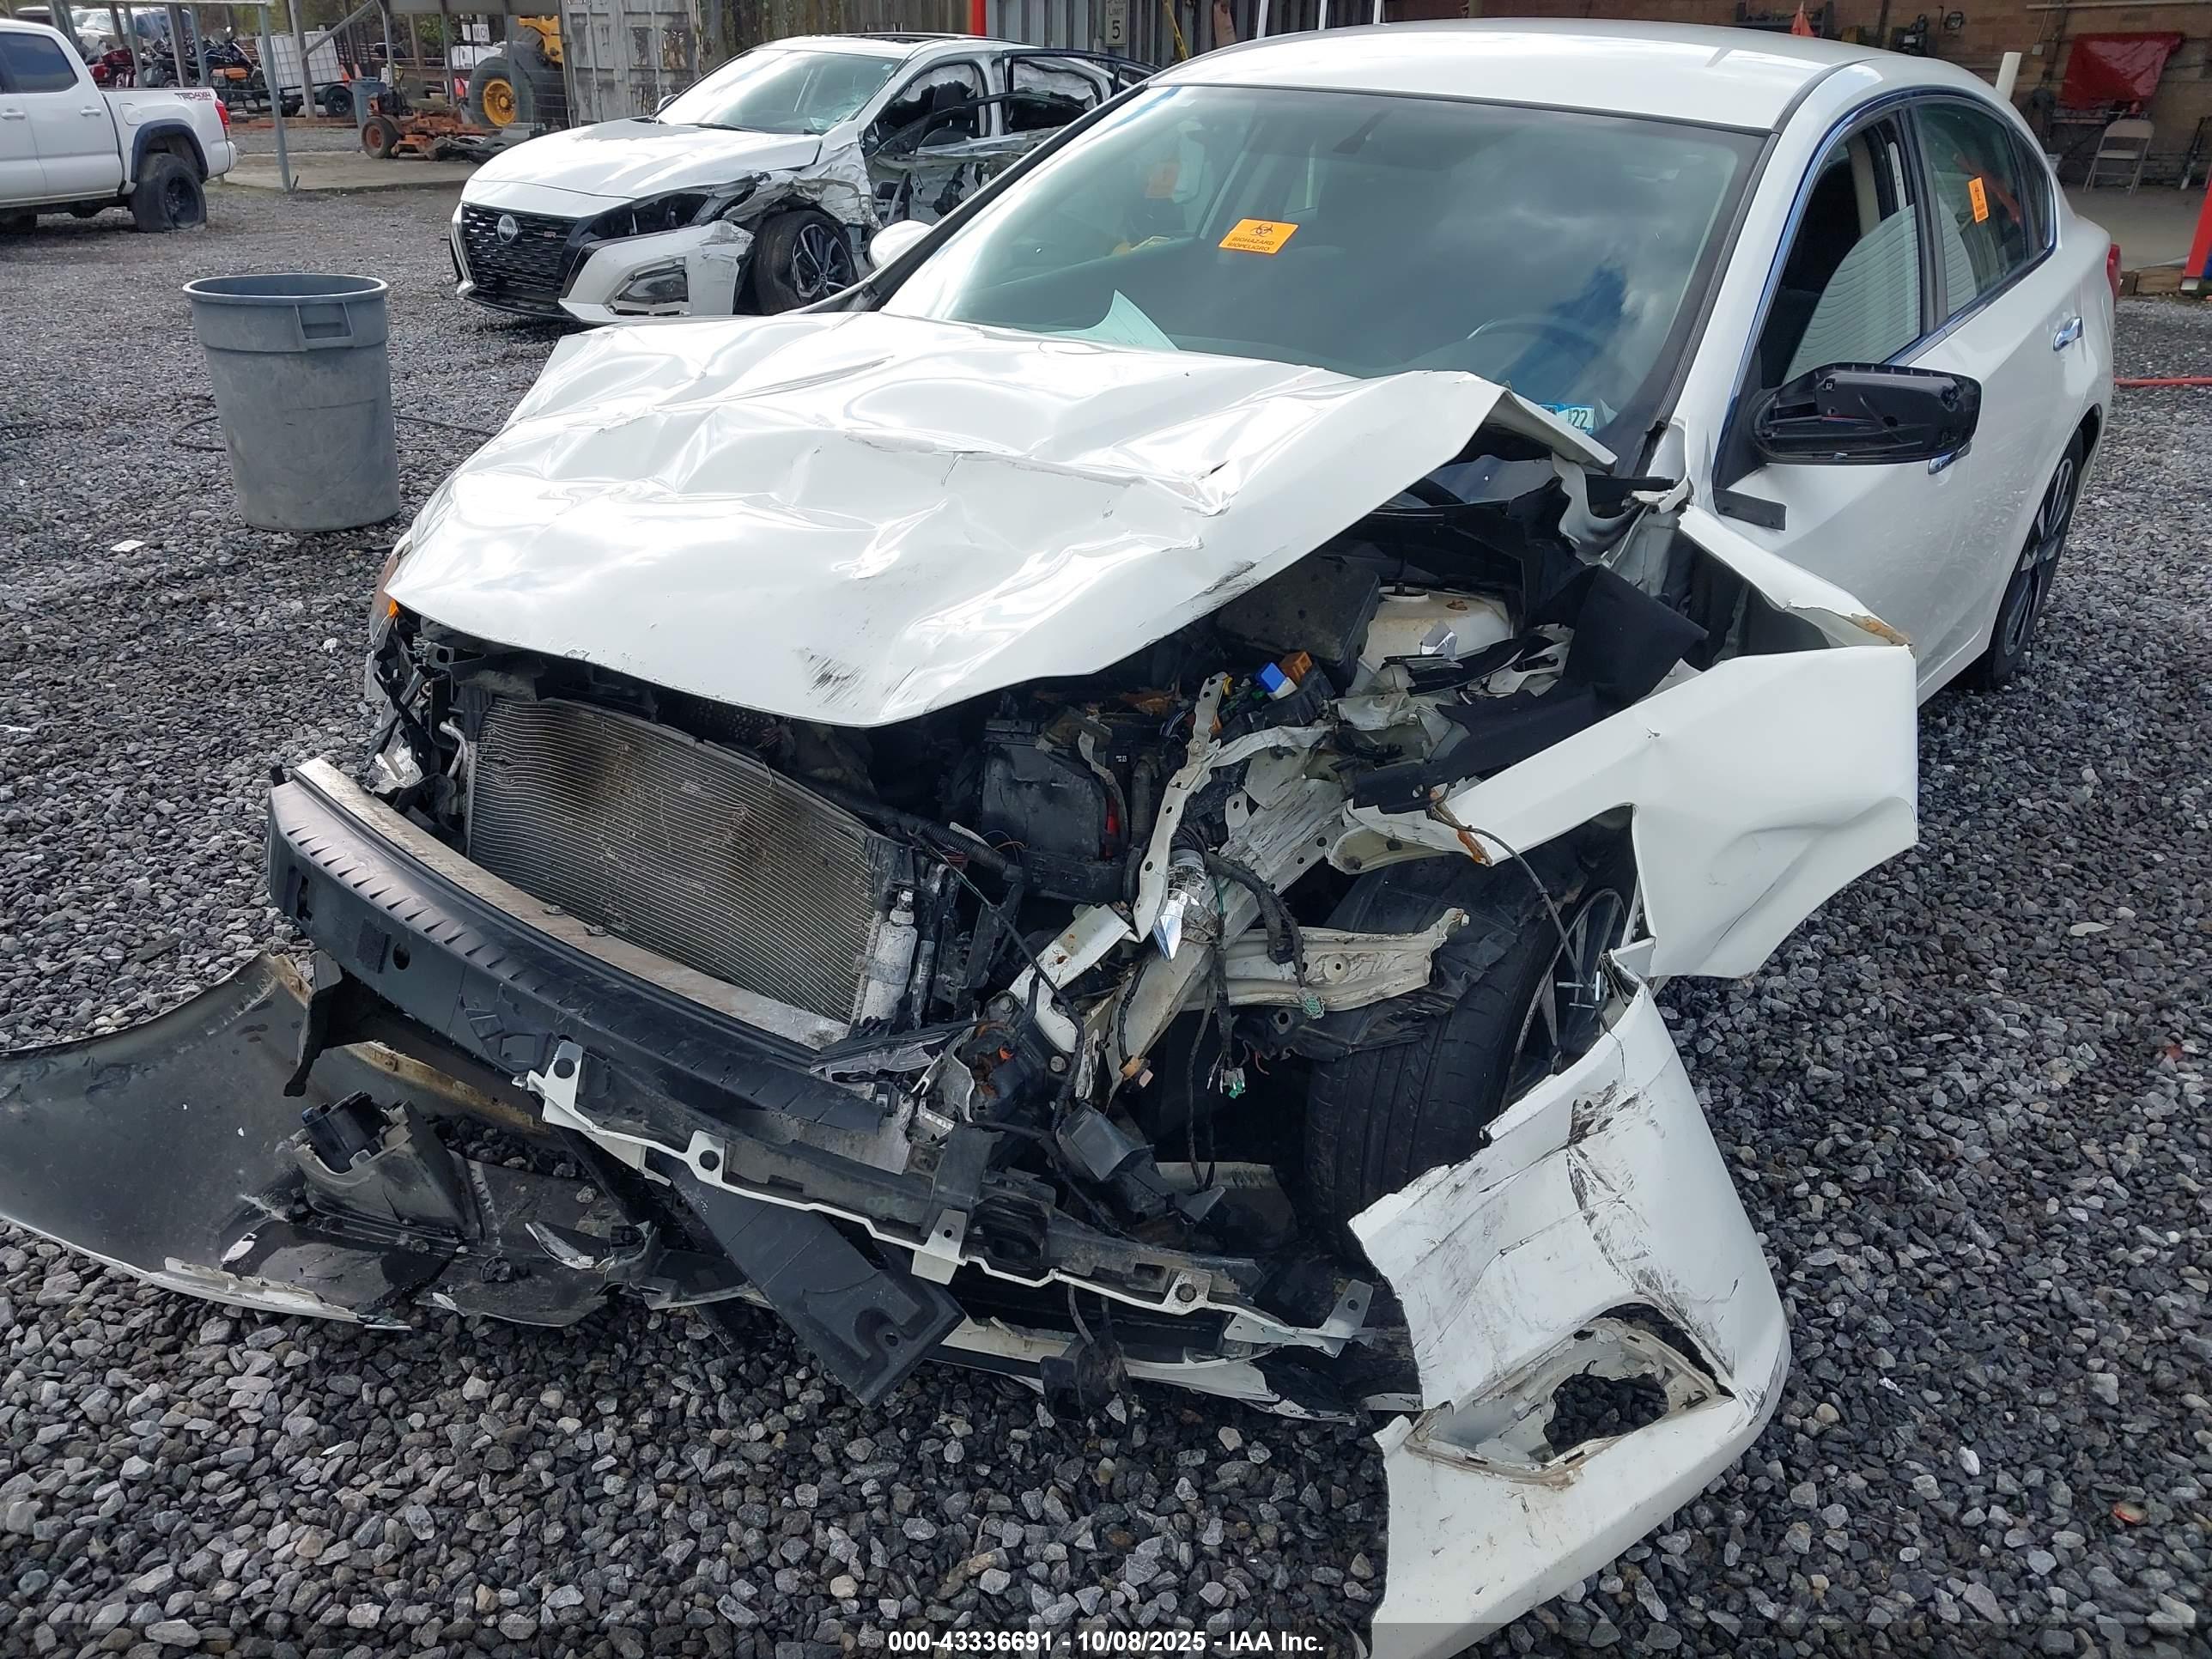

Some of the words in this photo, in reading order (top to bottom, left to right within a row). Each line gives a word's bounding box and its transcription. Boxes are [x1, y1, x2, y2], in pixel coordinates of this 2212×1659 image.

[1112, 19, 1121, 40] 5
[1227, 241, 1271, 252] BIOPELIGRO
[1231, 236, 1275, 246] BIOHAZARD
[1572, 409, 1588, 429] 22
